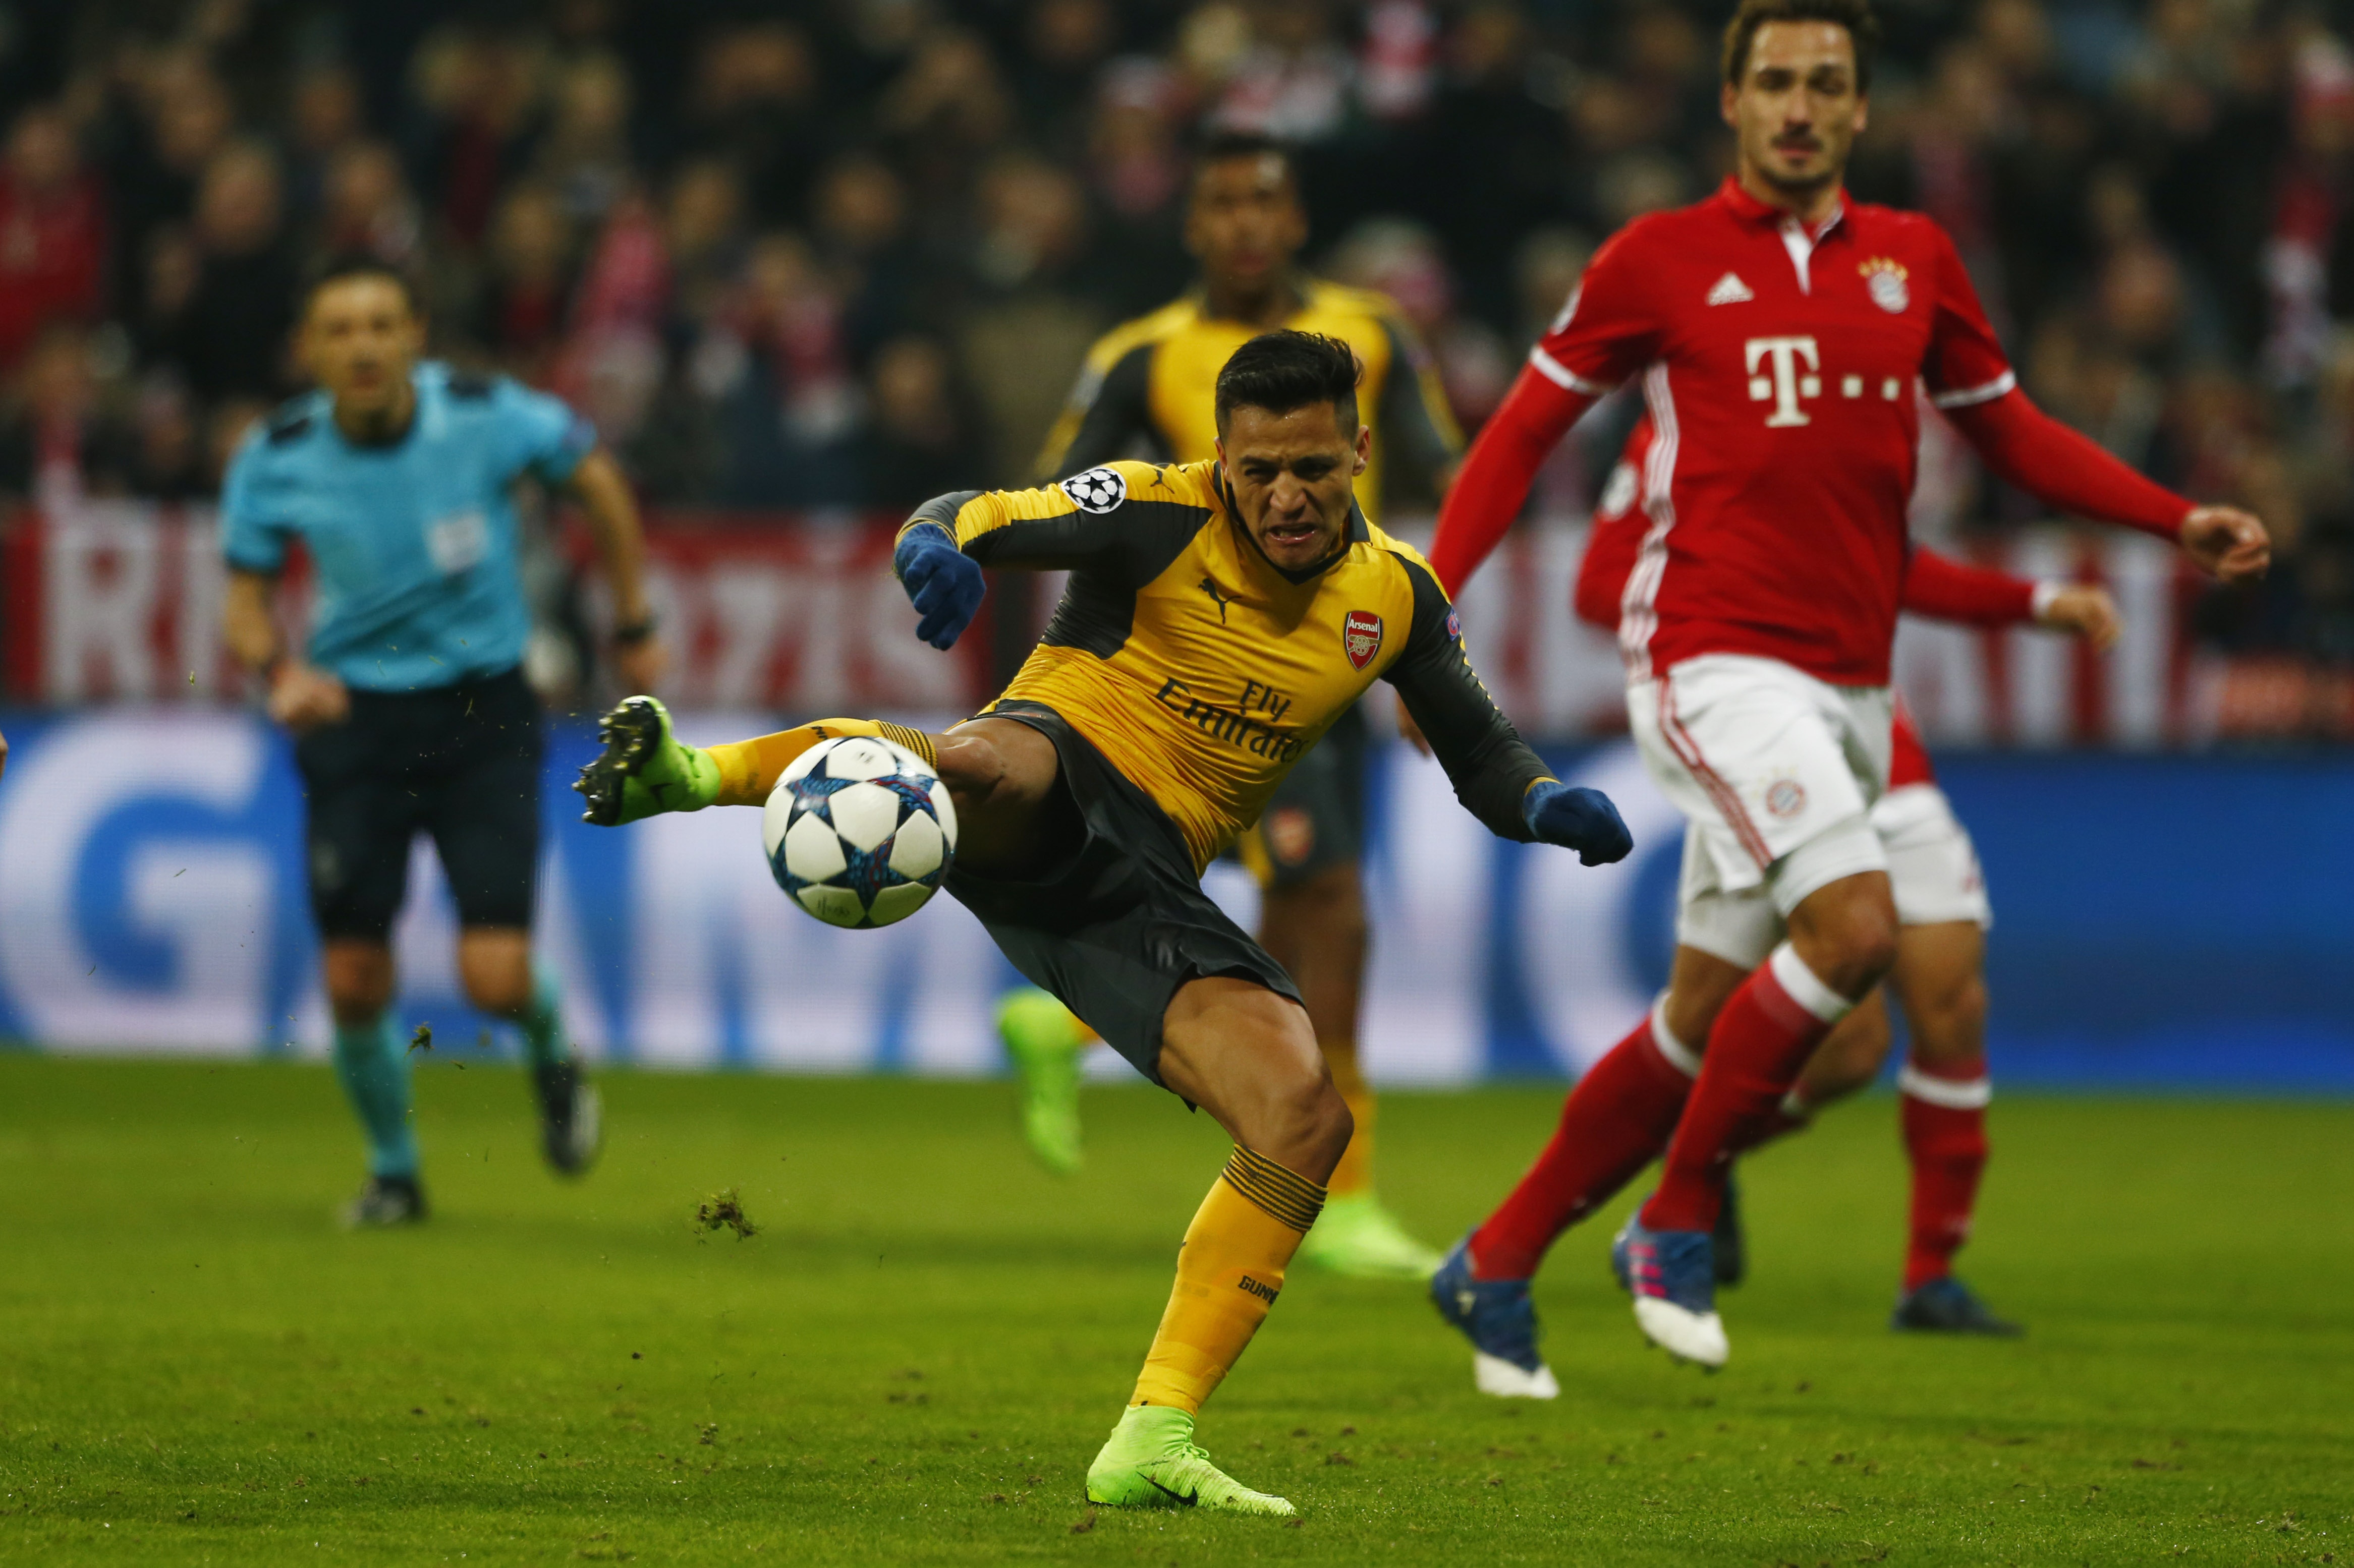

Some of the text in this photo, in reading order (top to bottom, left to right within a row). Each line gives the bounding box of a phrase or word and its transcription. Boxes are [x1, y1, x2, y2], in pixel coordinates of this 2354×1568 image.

[1349, 618, 1378, 633] Arsenal
[1156, 677, 1310, 764] Emirates
[1240, 679, 1292, 723] Fly
